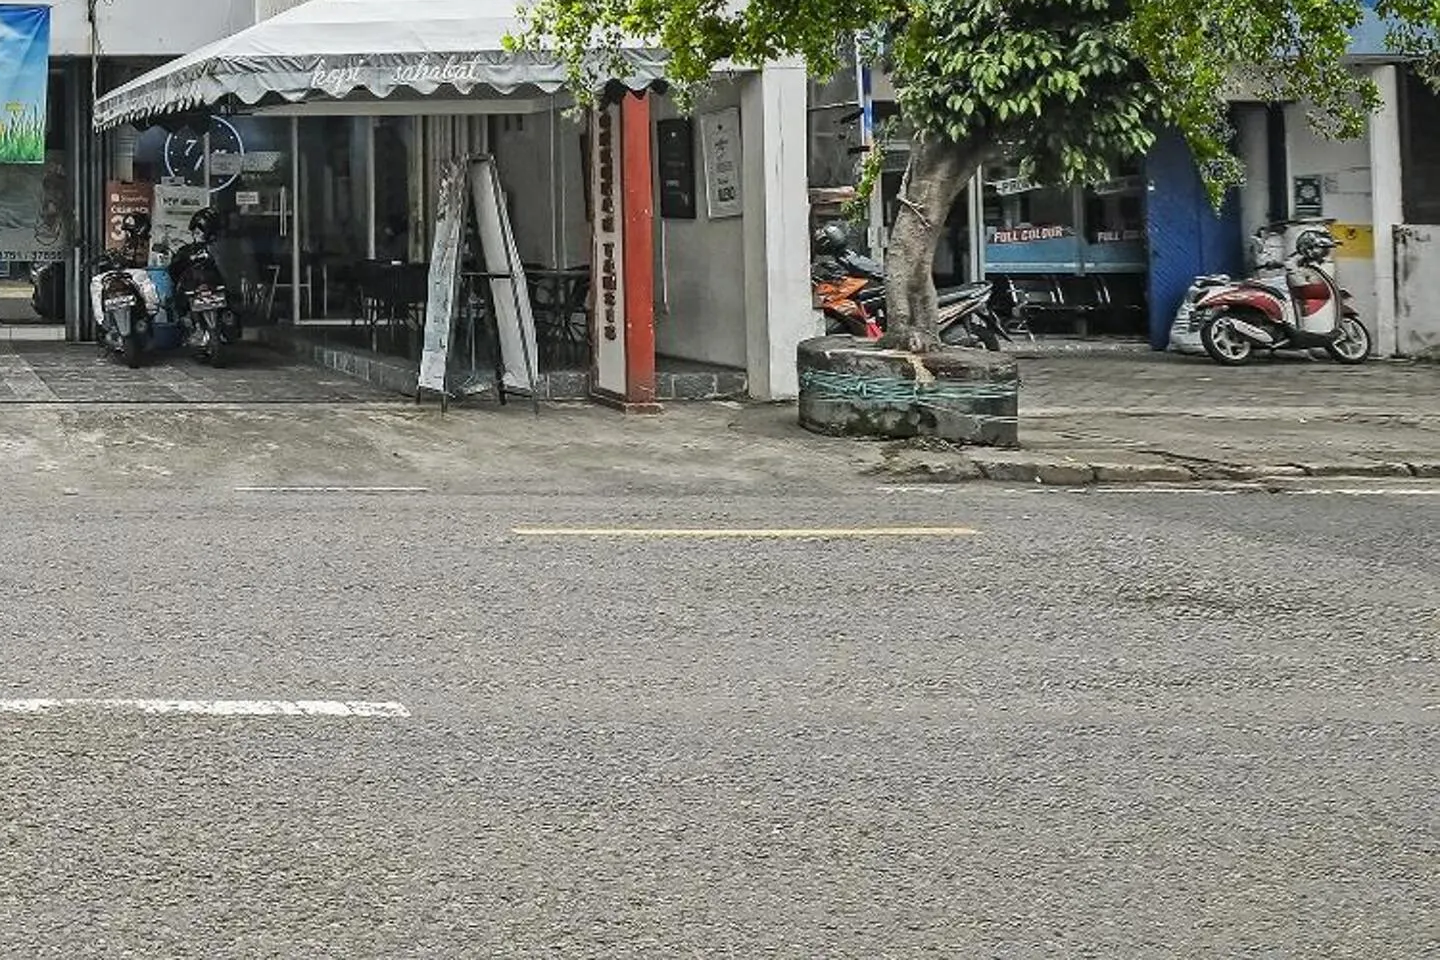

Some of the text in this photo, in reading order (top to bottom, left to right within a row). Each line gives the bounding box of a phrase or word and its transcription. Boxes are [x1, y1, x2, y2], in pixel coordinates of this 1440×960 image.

[311, 54, 481, 96] kopi sahabat
[994, 227, 1062, 243] FULL COLOUR
